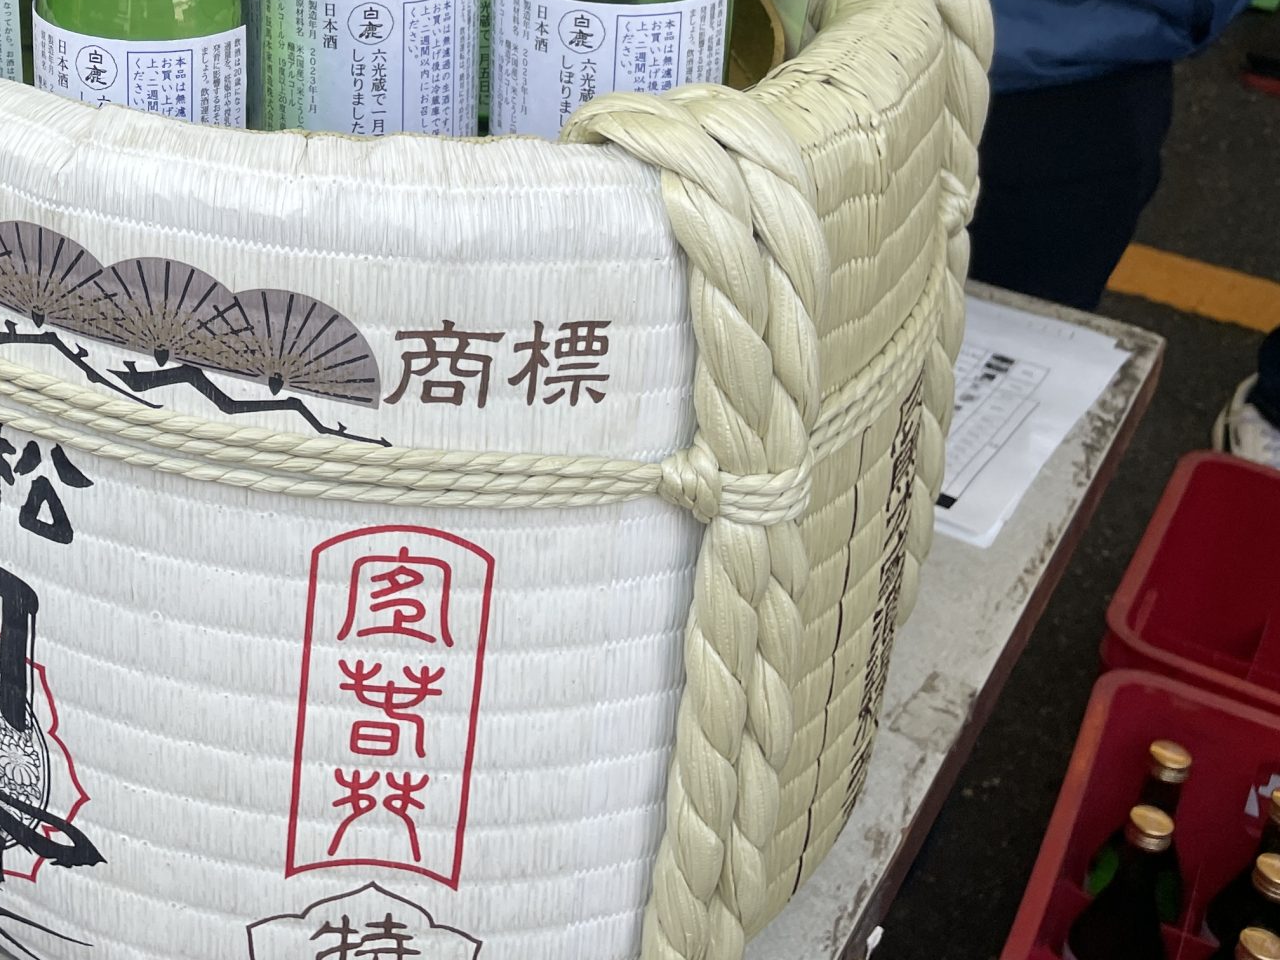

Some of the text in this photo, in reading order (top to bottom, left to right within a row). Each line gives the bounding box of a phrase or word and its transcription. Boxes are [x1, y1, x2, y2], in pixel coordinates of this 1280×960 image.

[323, 3, 338, 50] 日本酒
[358, 7, 383, 39] 白鹿
[534, 5, 549, 53] 日本酒
[569, 14, 594, 49] 白鹿
[85, 49, 107, 85] 白鹿
[420, 6, 431, 134] 上、二週間以内にお召し
[351, 49, 366, 134] しぼりました
[371, 49, 387, 137] 六光蔵で一月
[382, 320, 613, 408] 商標
